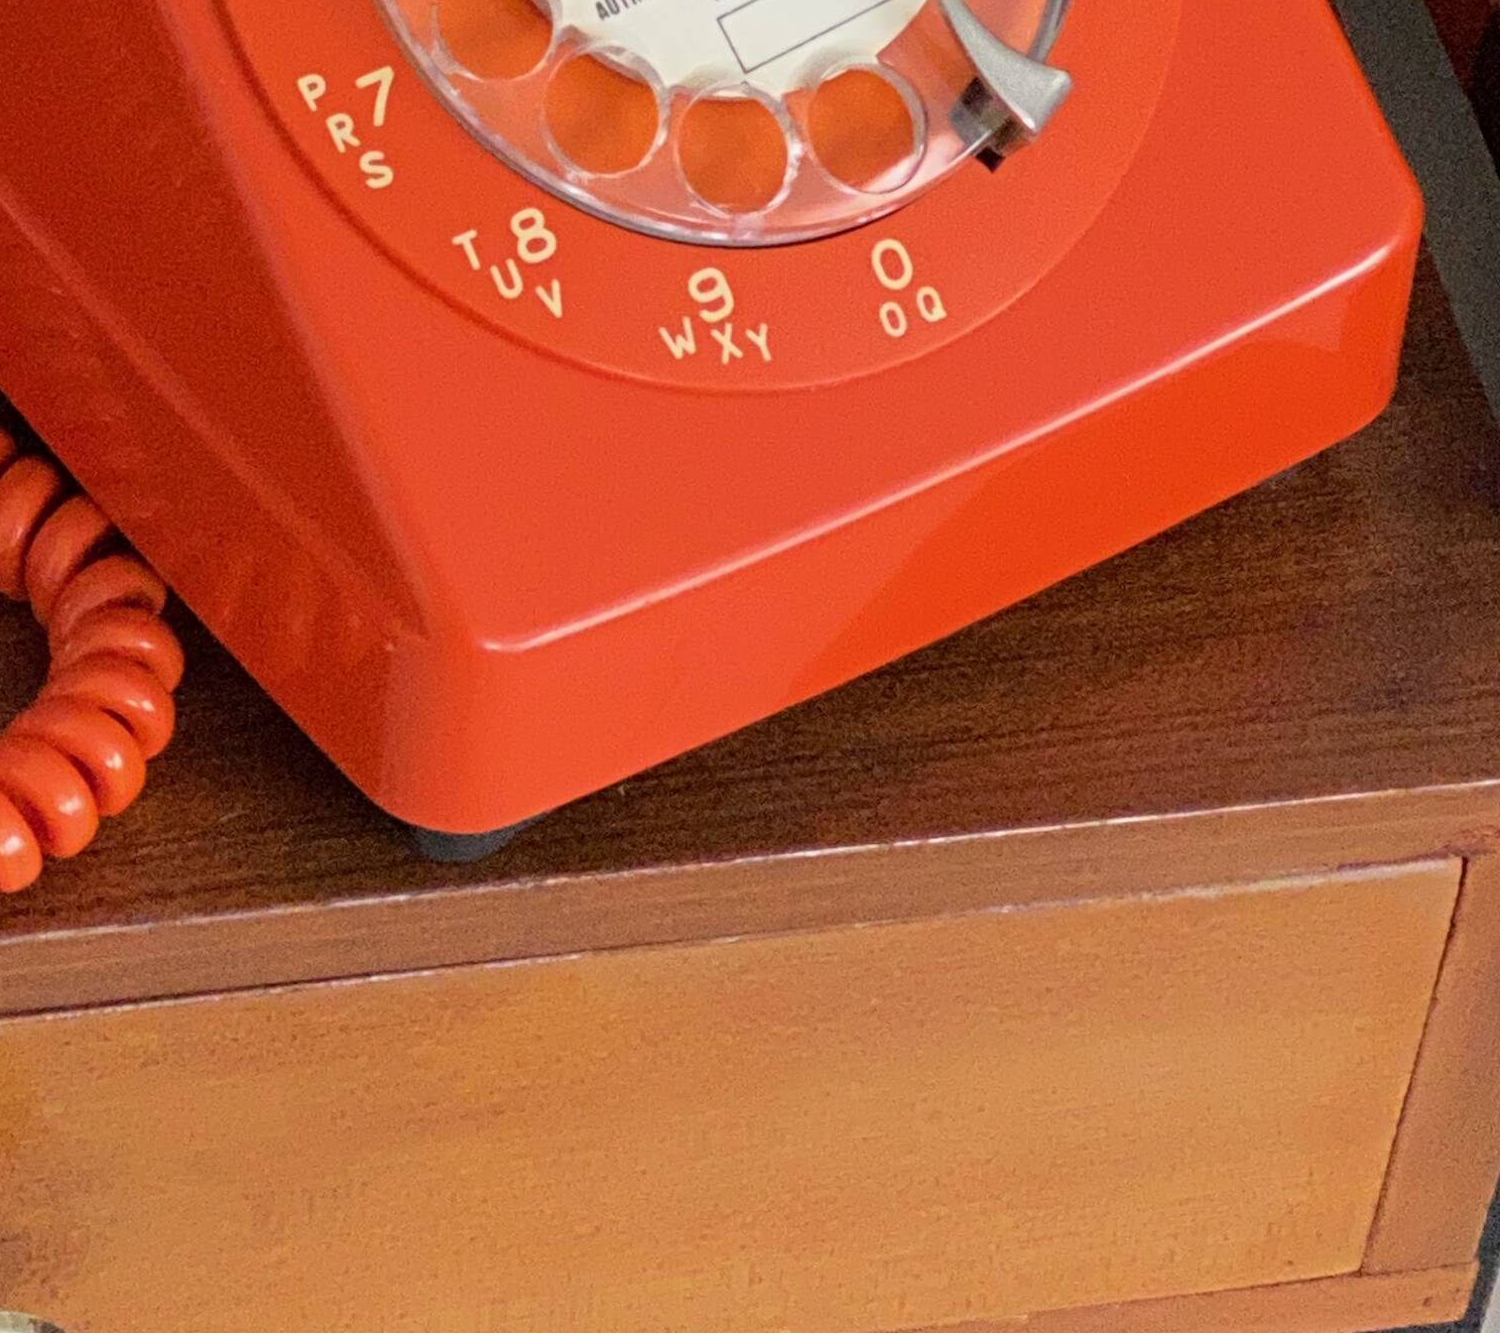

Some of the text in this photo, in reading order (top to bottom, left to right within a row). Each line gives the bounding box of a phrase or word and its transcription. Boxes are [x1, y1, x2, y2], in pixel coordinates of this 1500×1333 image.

[356, 66, 394, 126] 7
[511, 208, 556, 263] 8
[452, 230, 562, 317] TUV
[872, 239, 913, 289] 0
[688, 268, 734, 322] 9
[659, 317, 771, 364] WXY
